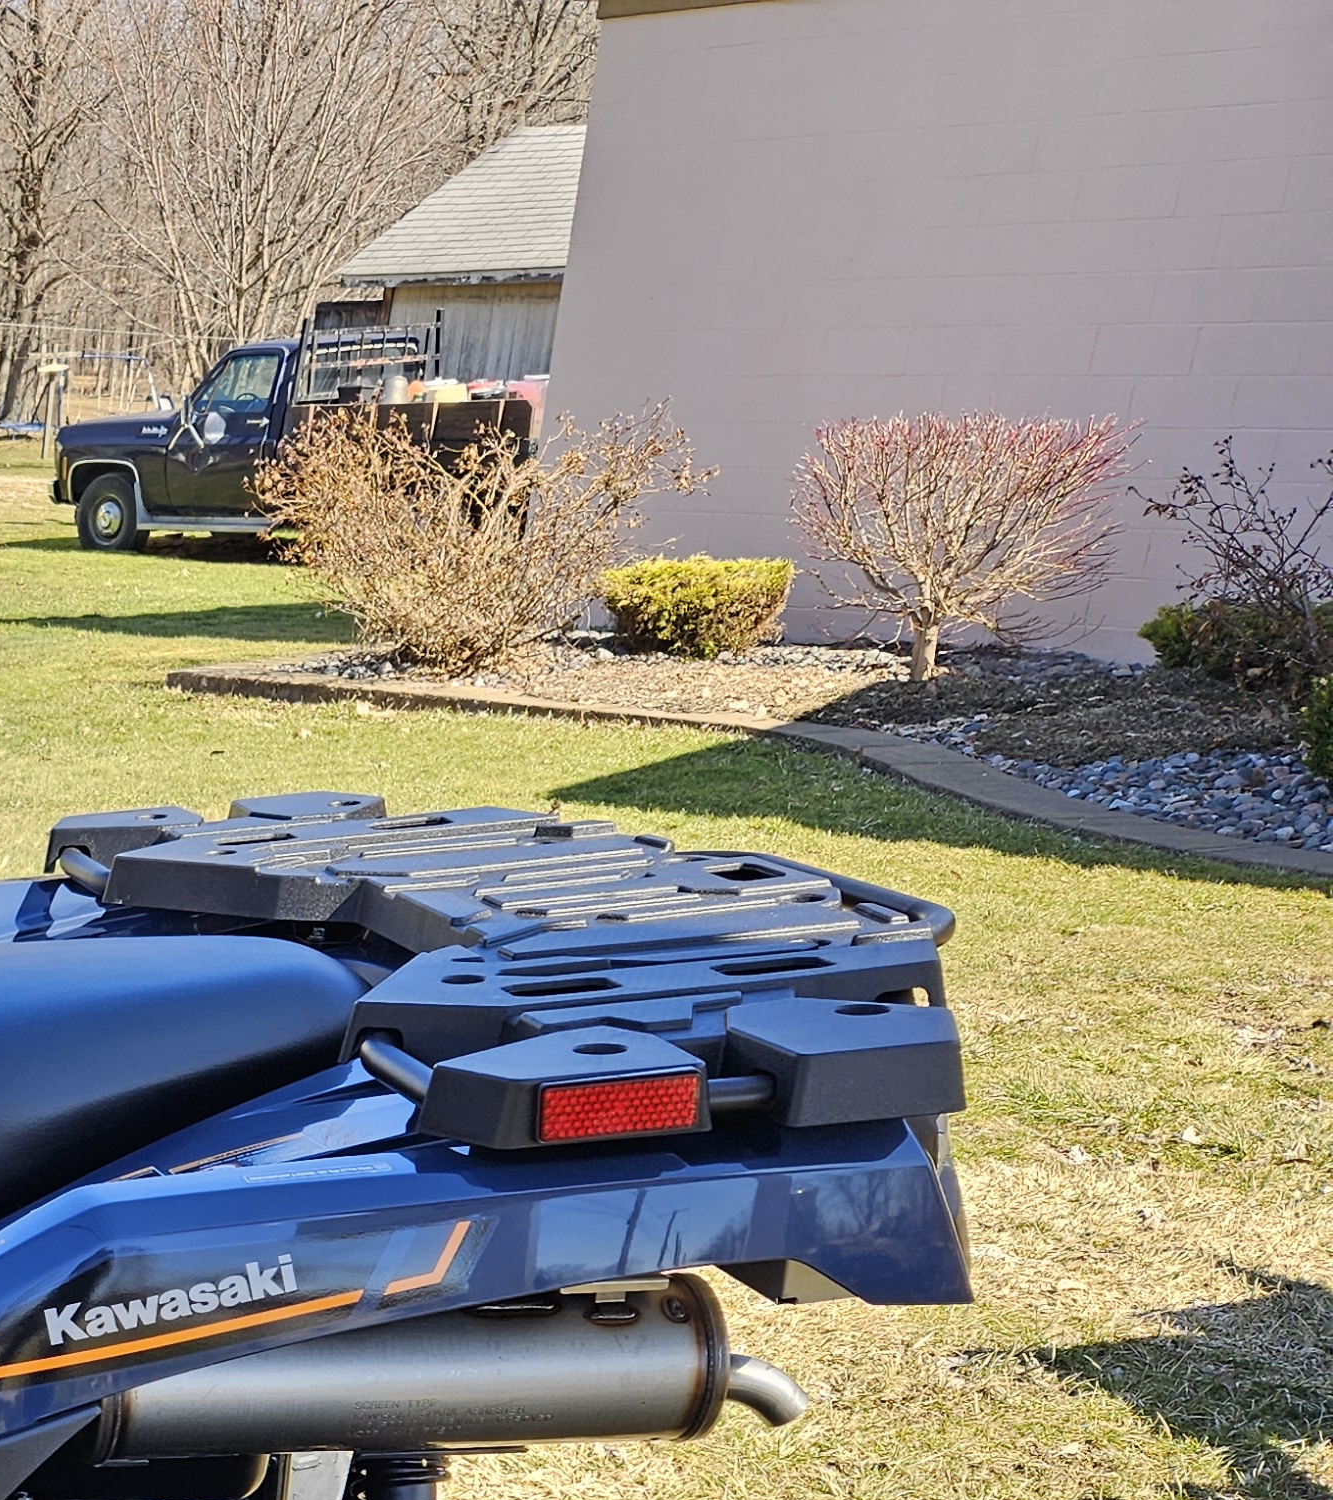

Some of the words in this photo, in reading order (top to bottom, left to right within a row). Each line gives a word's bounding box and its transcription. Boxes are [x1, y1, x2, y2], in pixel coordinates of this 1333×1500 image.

[43, 1253, 299, 1346] Kawasaki
[354, 1400, 400, 1411] SCREEN
[408, 1399, 437, 1409] TYPE
[420, 1408, 457, 1418] SPARK
[466, 1406, 526, 1416] ARRESTER
